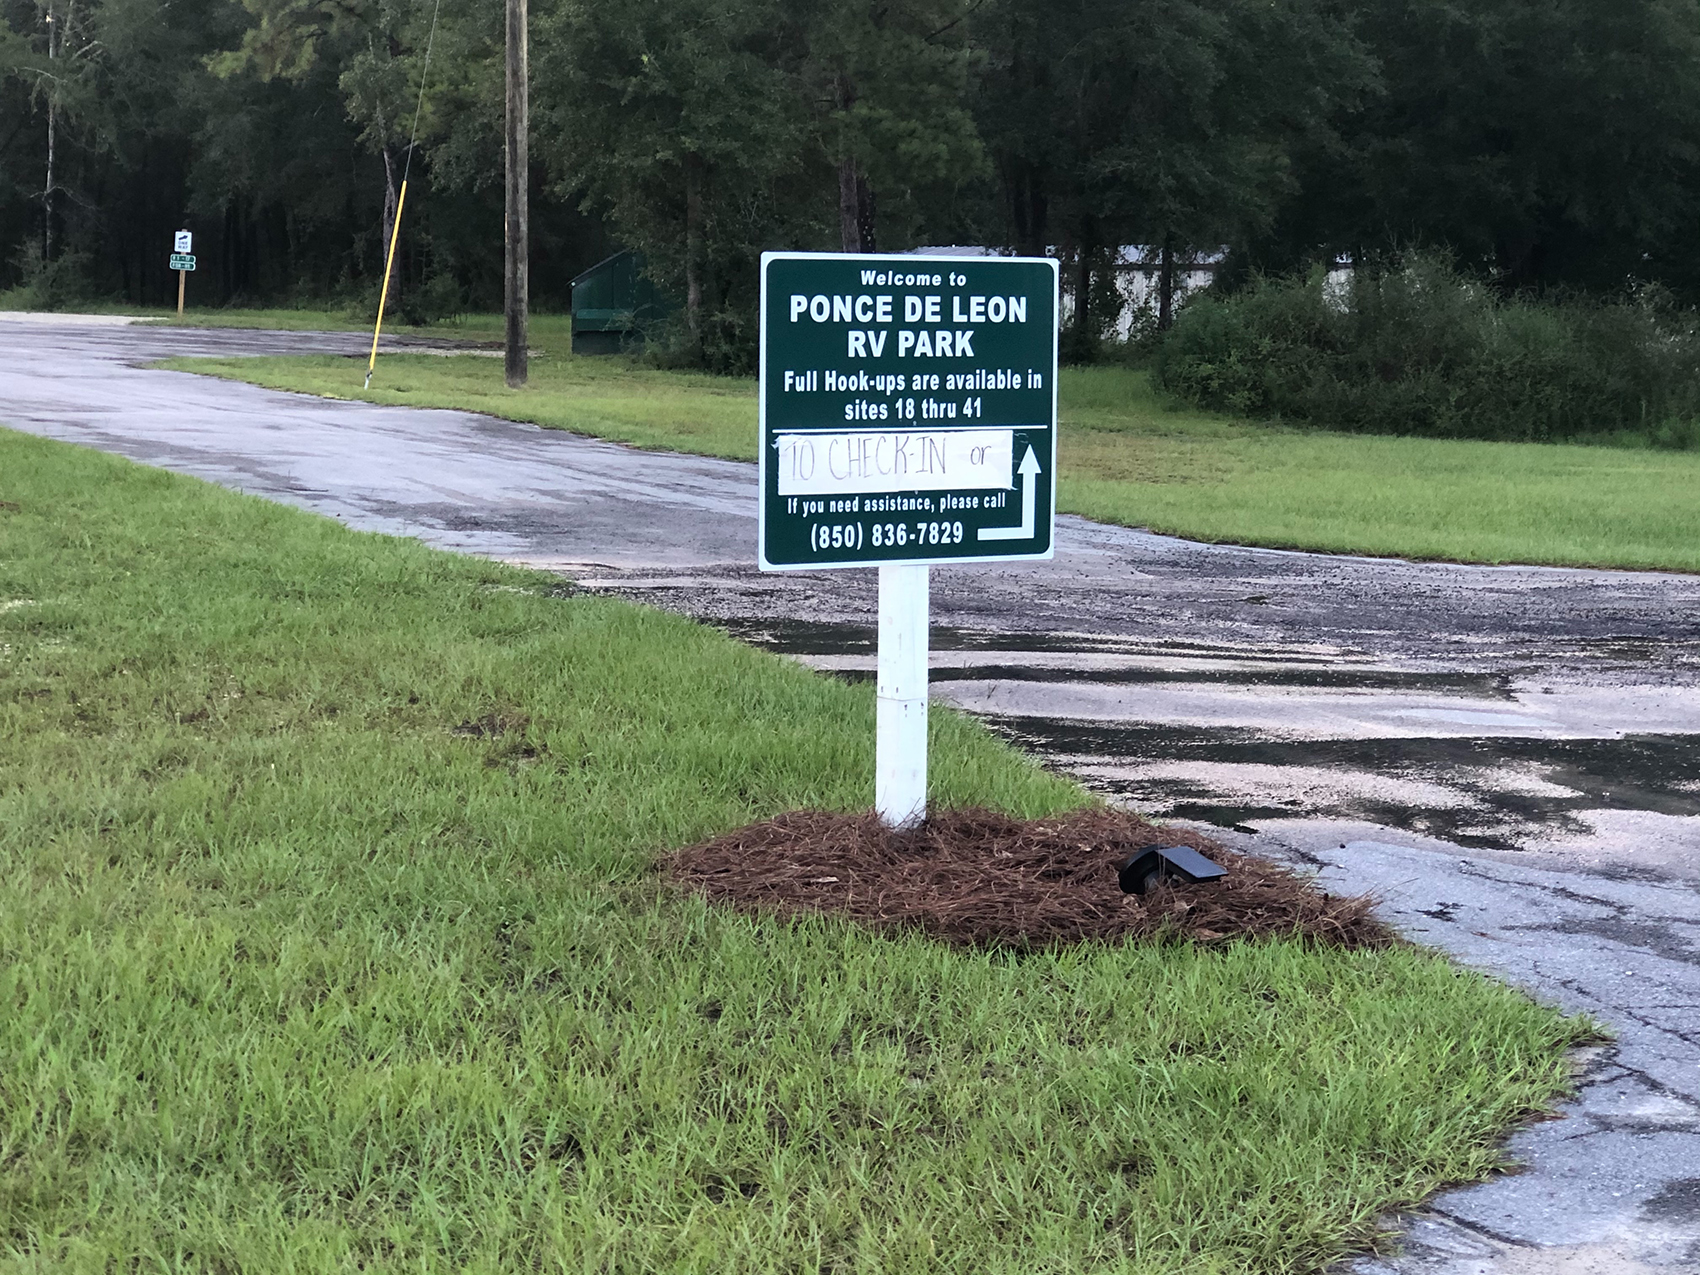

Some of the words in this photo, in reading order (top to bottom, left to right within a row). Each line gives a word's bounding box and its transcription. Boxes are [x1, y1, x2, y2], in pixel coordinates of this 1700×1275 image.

[861, 270, 942, 286] Welcome
[949, 271, 967, 287] to
[790, 295, 893, 322] PONCE
[904, 295, 942, 322] DE
[952, 296, 1026, 323] LEON
[848, 330, 887, 357] RV
[898, 330, 975, 357] PARK
[784, 370, 817, 392] Full
[824, 370, 905, 395] Hook-ups
[912, 374, 940, 391] are
[946, 369, 1021, 390] available
[1027, 369, 1042, 389] in
[844, 399, 888, 420] sites
[895, 397, 915, 419] 18
[921, 397, 957, 419] thru
[963, 397, 982, 418] 41
[784, 438, 815, 482] TO
[828, 435, 946, 480] CHECK-IN
[970, 445, 992, 466] or
[787, 498, 799, 515] If
[802, 500, 825, 517] you
[829, 496, 859, 513] need
[864, 494, 935, 514] assistance,
[939, 494, 979, 513] please
[983, 492, 1006, 509] call
[810, 522, 863, 552] (850)
[871, 521, 964, 547] 836-7829
